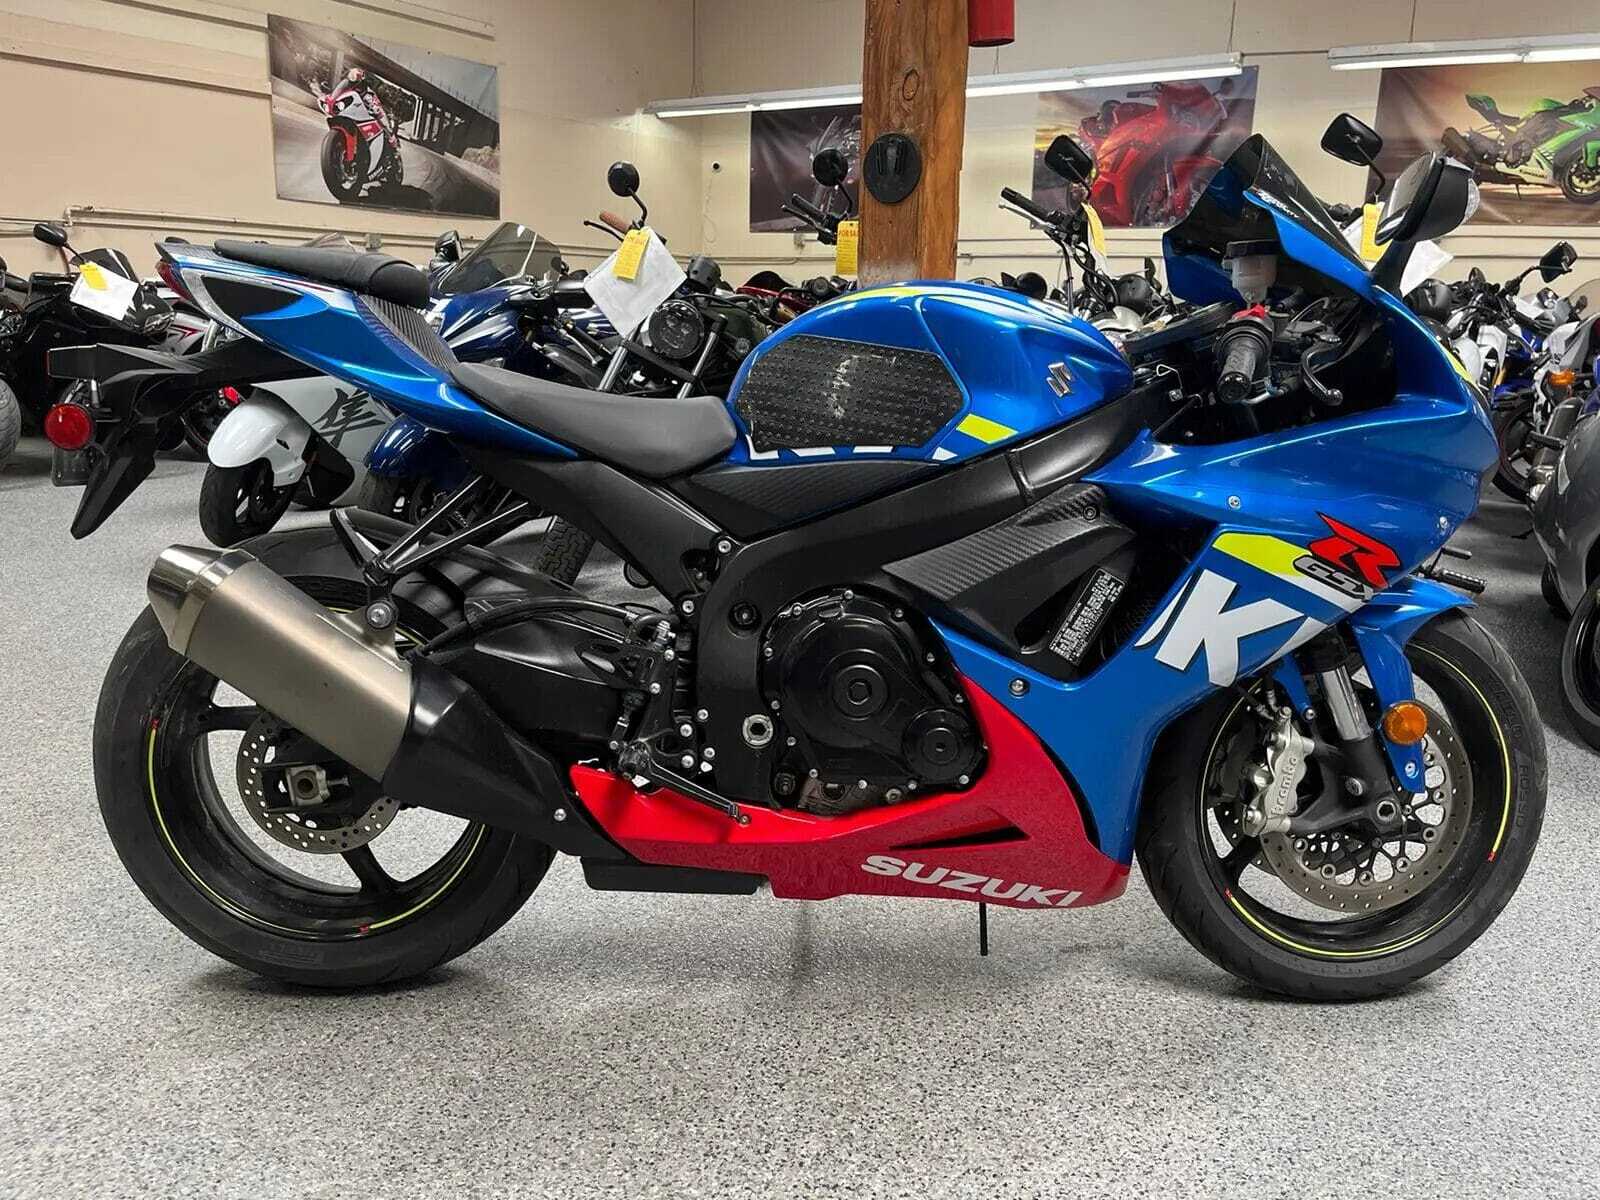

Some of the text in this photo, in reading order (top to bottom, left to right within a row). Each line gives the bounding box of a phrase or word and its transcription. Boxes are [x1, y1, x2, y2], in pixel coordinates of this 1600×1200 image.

[1308, 511, 1401, 590] R
[1271, 757, 1298, 815] brembo
[861, 855, 1082, 907] SUZUKI
